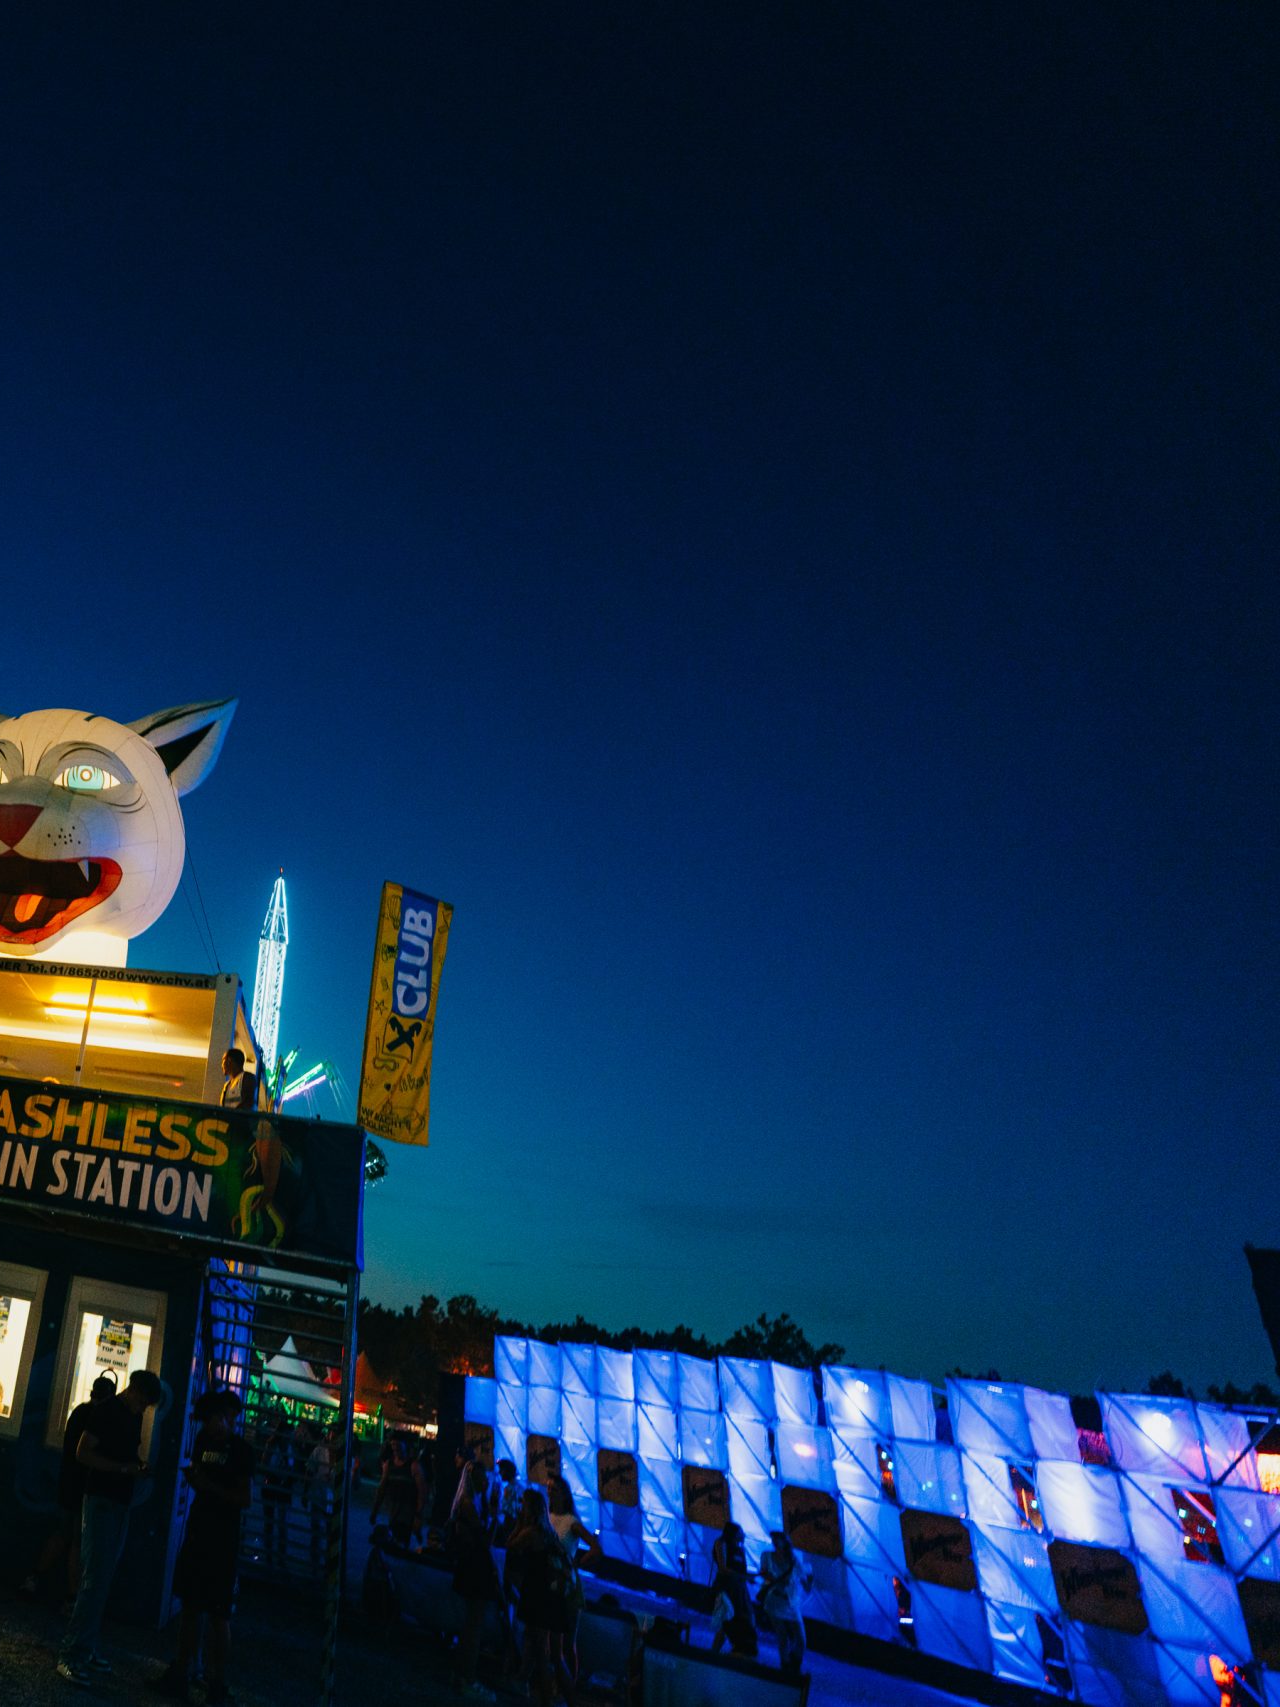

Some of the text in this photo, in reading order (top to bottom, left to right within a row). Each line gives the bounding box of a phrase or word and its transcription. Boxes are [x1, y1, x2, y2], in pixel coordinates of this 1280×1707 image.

[26, 962, 47, 973] Tel.
[50, 965, 124, 980] 01/8652050
[126, 973, 210, 987] www.chv.at
[396, 907, 434, 1016] CLUB
[46, 1149, 213, 1222] STATION
